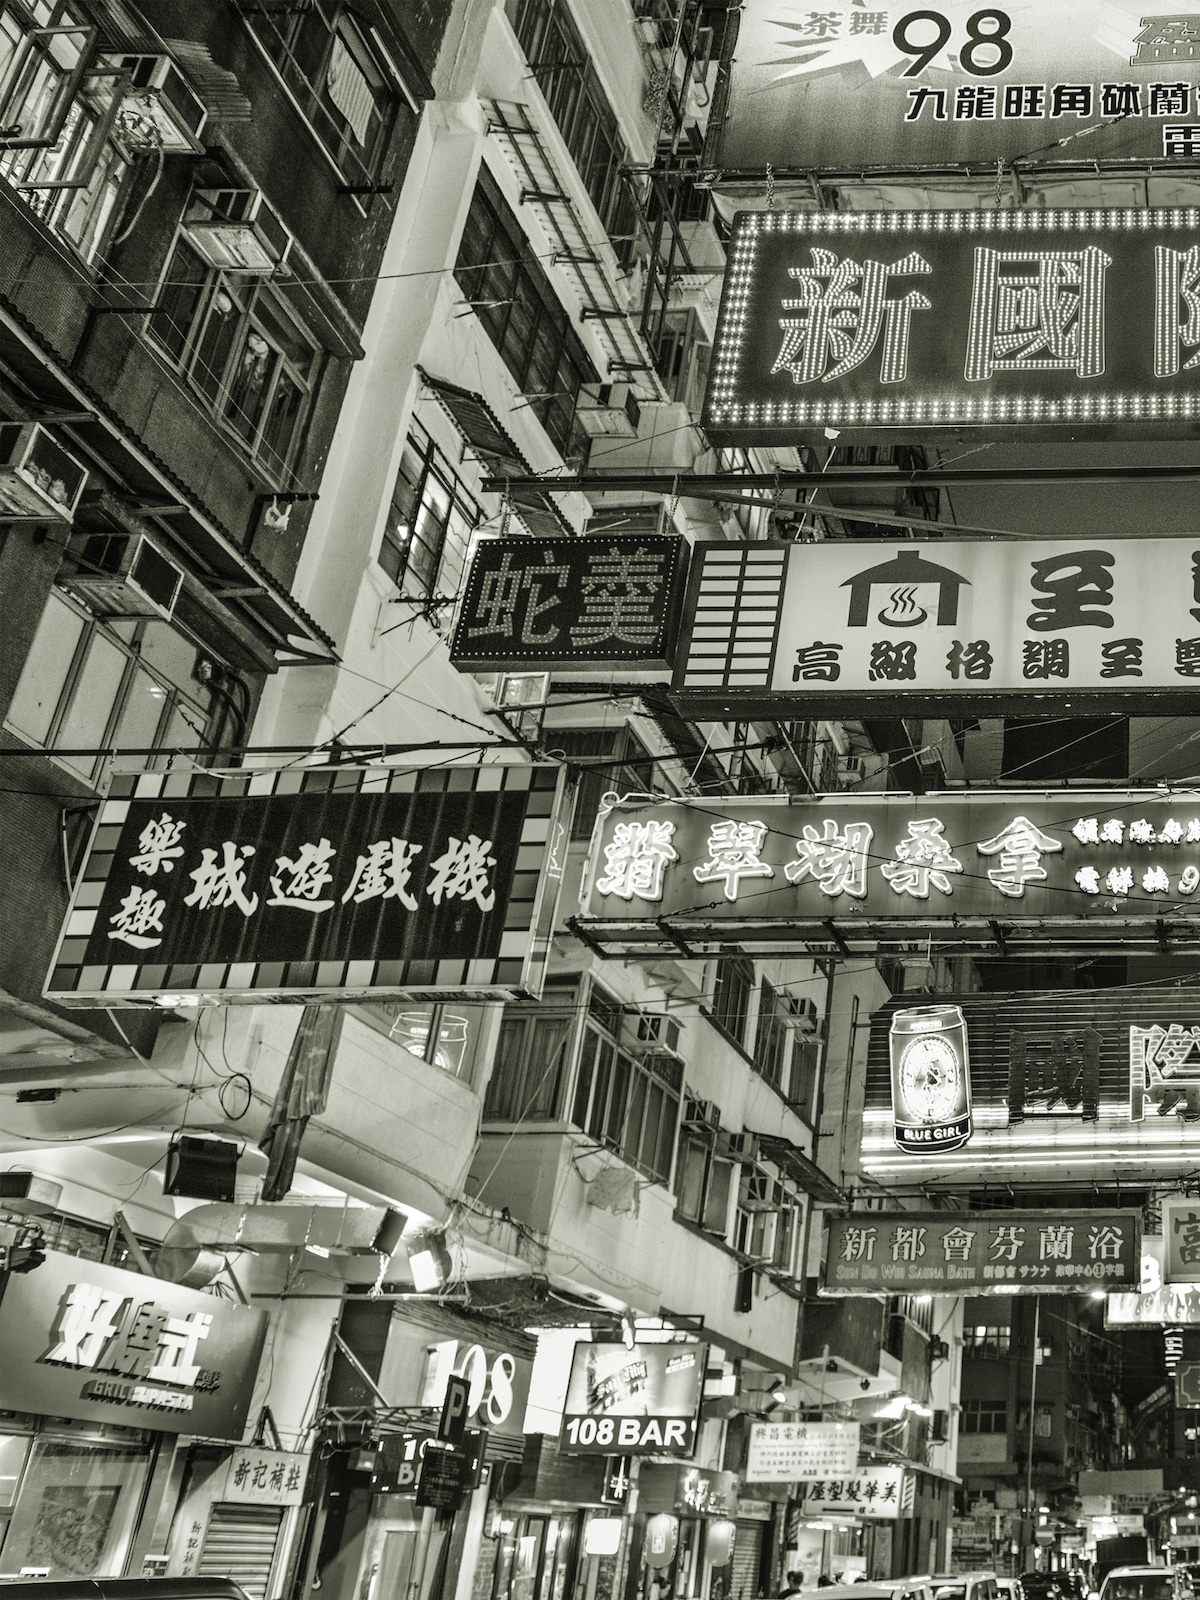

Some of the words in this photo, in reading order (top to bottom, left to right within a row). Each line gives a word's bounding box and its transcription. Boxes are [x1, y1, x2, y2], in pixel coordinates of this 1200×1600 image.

[466, 547, 665, 647] 蛇羹
[904, 1128, 932, 1141] BLUE
[933, 1126, 962, 1139] GIRL
[839, 1225, 1124, 1262] 新都會芬蘭浴
[443, 1382, 466, 1438] P
[566, 1417, 615, 1446] 108
[618, 1418, 687, 1447] BAR
